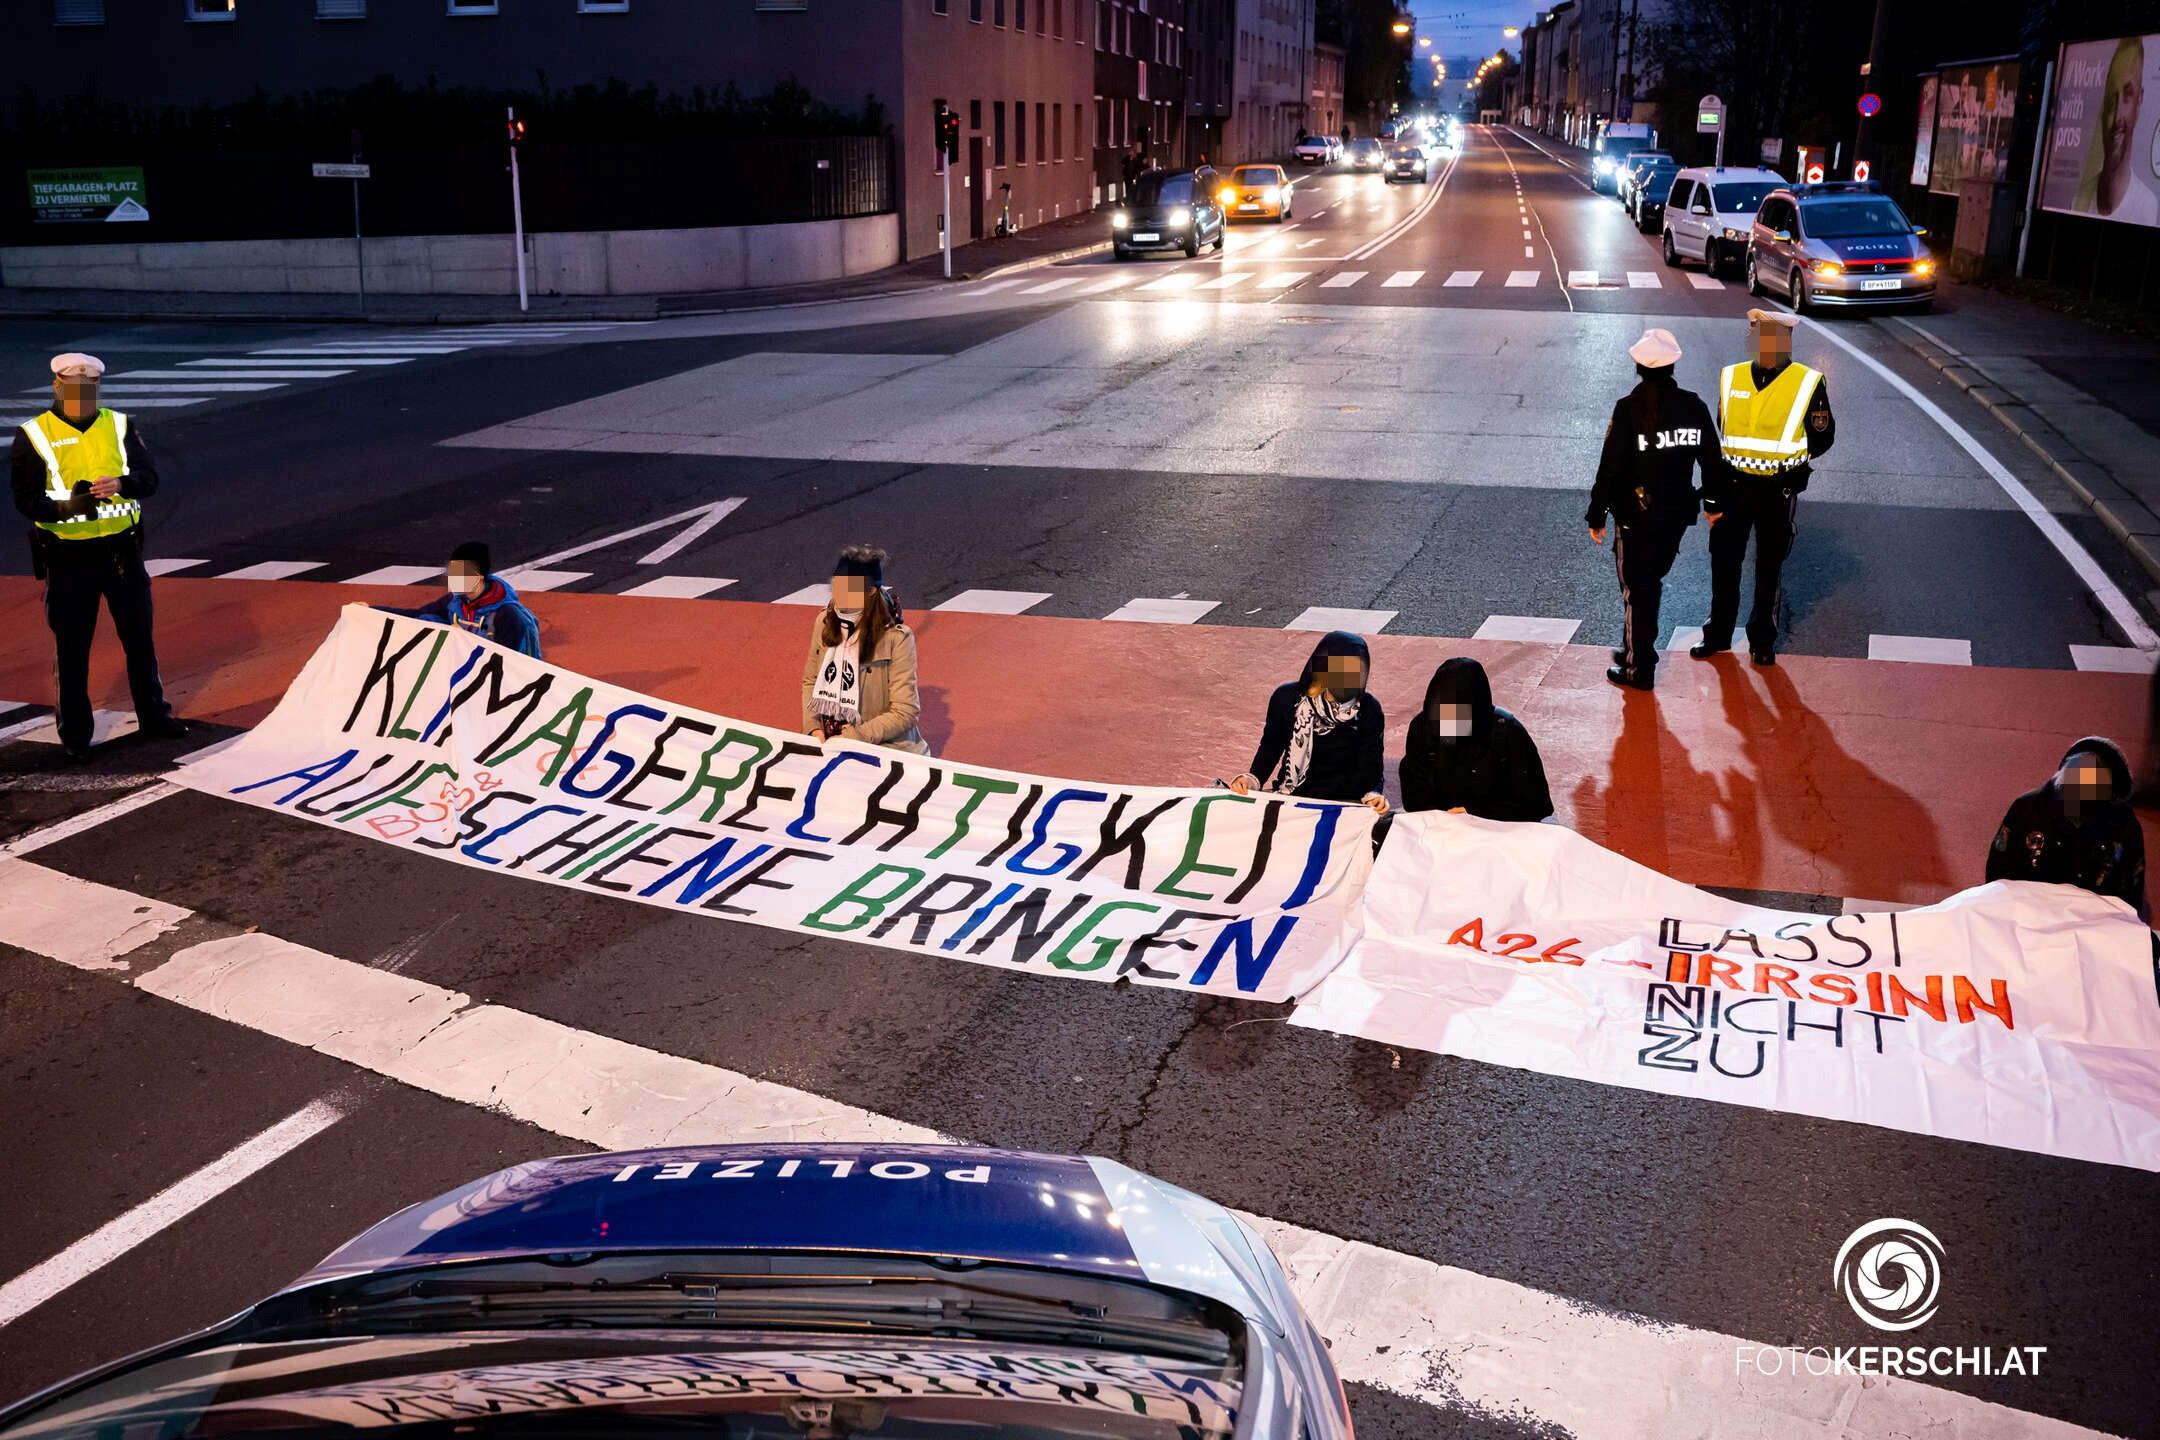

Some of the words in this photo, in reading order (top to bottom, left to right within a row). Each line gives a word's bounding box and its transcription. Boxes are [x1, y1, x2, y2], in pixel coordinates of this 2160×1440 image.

[2061, 93, 2083, 120] with
[2055, 127, 2081, 152] pros
[33, 182, 138, 193] TIEFGARAGEN-PLATZ
[35, 196, 48, 204] ZU
[1847, 243, 1899, 251] POLIZEI
[343, 617, 1343, 910] KLIMAGERECHTIGKEIT
[230, 749, 459, 822] AUF
[414, 791, 833, 916] SCHIENE
[799, 862, 1298, 993] BRINGEN
[1447, 917, 1585, 967] A26
[1667, 951, 2015, 1030] IRRSINN
[1646, 983, 1905, 1054] NICHT
[1637, 1023, 1765, 1079] ZU
[612, 1160, 990, 1184] POLIZEI
